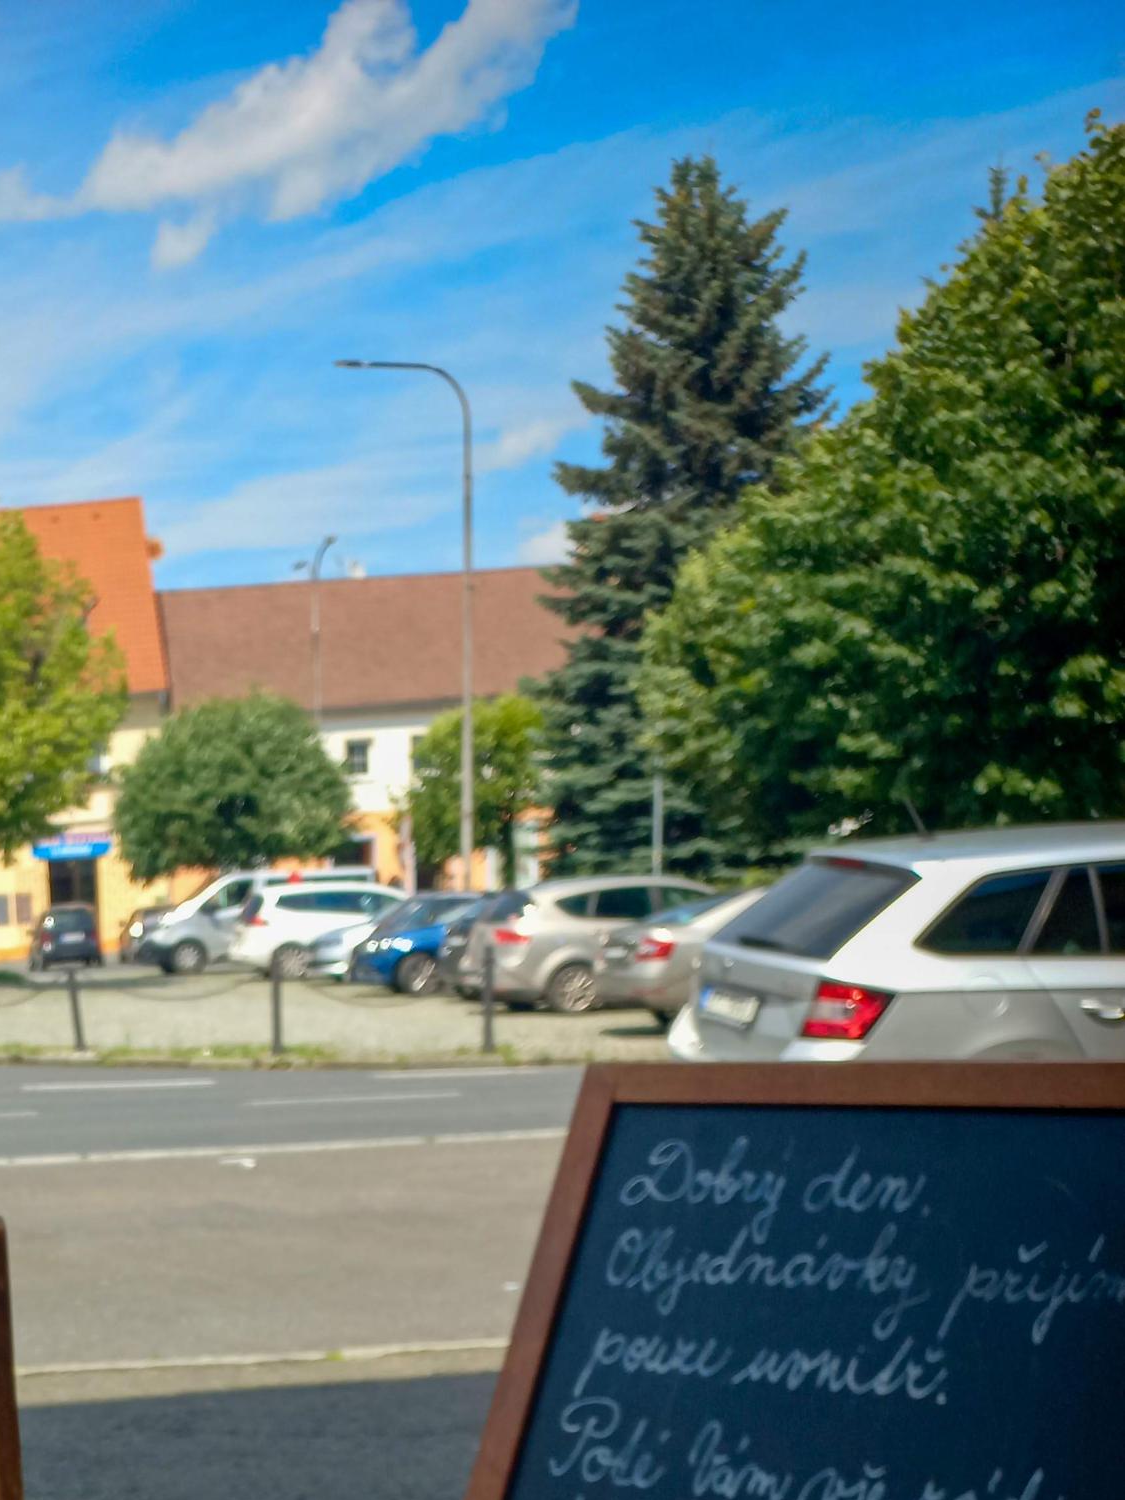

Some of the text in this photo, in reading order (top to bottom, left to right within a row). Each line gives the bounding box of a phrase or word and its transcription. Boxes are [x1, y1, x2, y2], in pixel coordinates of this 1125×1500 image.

[620, 1136, 930, 1244] Dobrý den.
[606, 1222, 930, 1340] Objednávky
[575, 1326, 732, 1396] pouze
[548, 1397, 672, 1489] Poté
